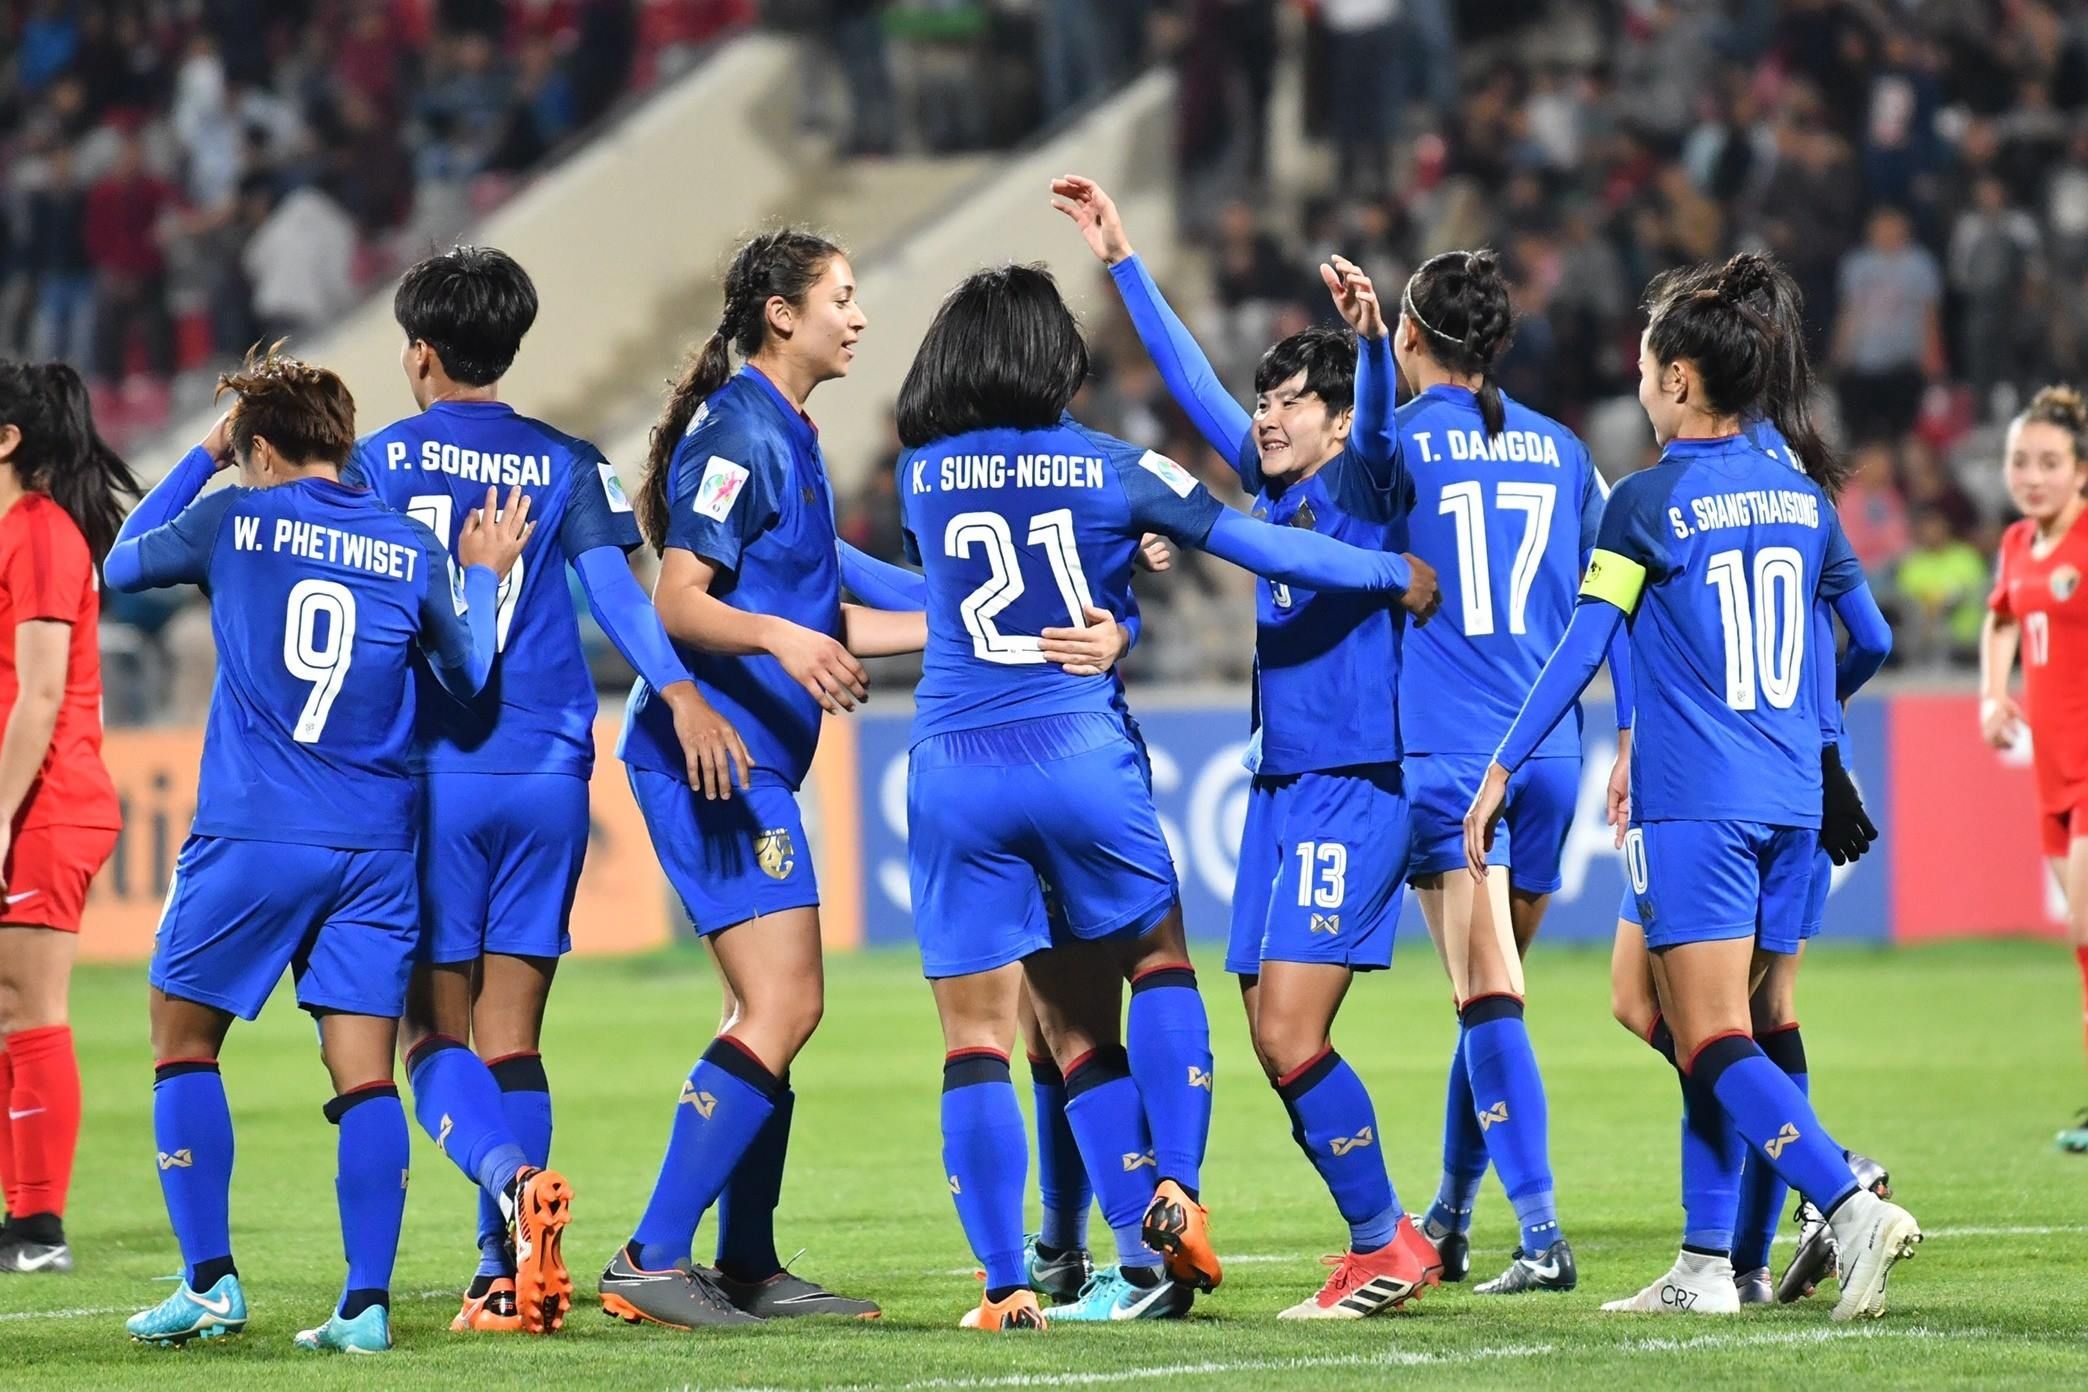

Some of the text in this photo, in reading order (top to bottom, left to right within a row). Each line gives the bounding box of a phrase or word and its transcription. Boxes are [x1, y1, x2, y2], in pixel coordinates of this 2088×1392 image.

[387, 440, 550, 486] P. SORNSAI
[913, 454, 1104, 494] K. SUNG-NGOEN
[1413, 430, 1560, 467] T. DANGDA
[1668, 490, 1819, 539] S. SRANGTHAISONG
[234, 515, 417, 582] W. PHETWISET
[1438, 480, 1557, 636] 17
[944, 507, 1095, 665] 21
[283, 579, 356, 744] 9
[1706, 546, 1805, 710] 10
[1295, 841, 1347, 909] 13
[1661, 1284, 1699, 1310] CR7
